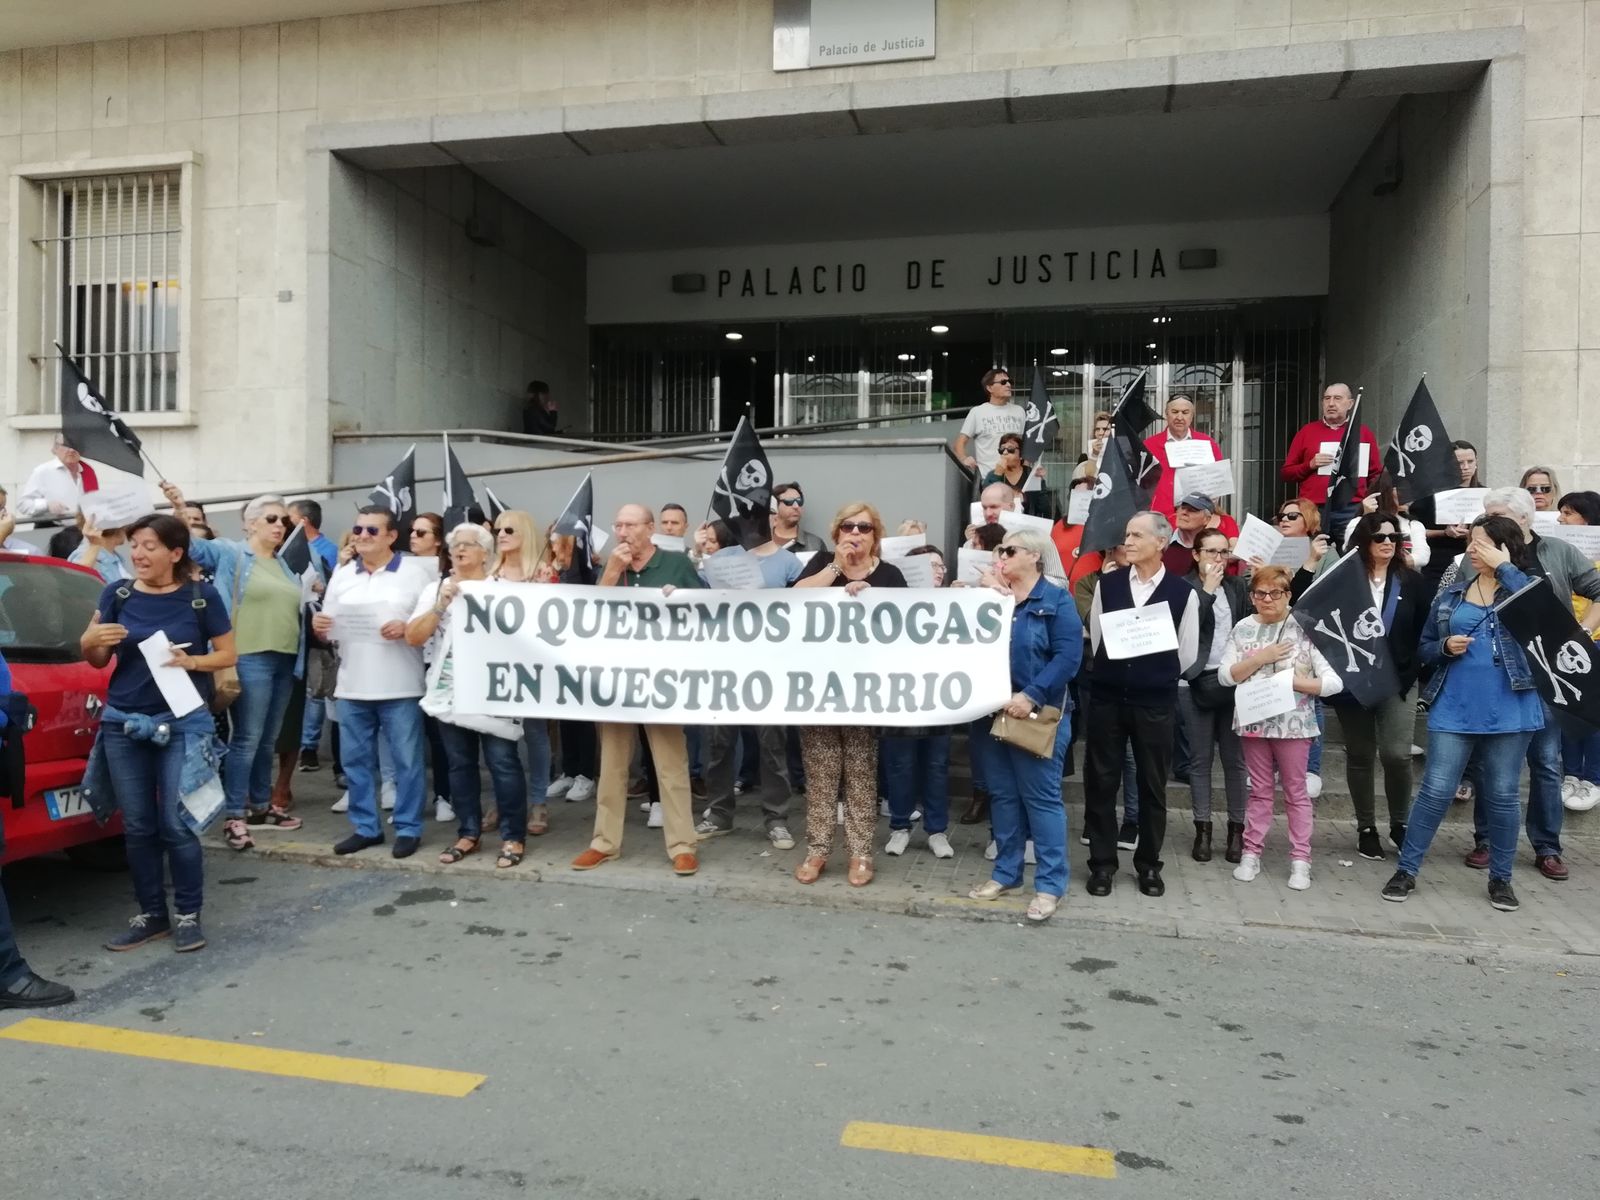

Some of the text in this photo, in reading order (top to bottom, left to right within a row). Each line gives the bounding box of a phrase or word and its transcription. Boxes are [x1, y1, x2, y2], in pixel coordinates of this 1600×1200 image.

[818, 36, 925, 57] Palacio de Justicia
[717, 248, 1167, 299] PALACIO DE JUSTICIA
[463, 593, 1003, 647] NO QUEREMOS DROGAS
[485, 661, 543, 704] EN
[554, 664, 773, 712] NUESTRO
[784, 670, 973, 714] BARRIO
